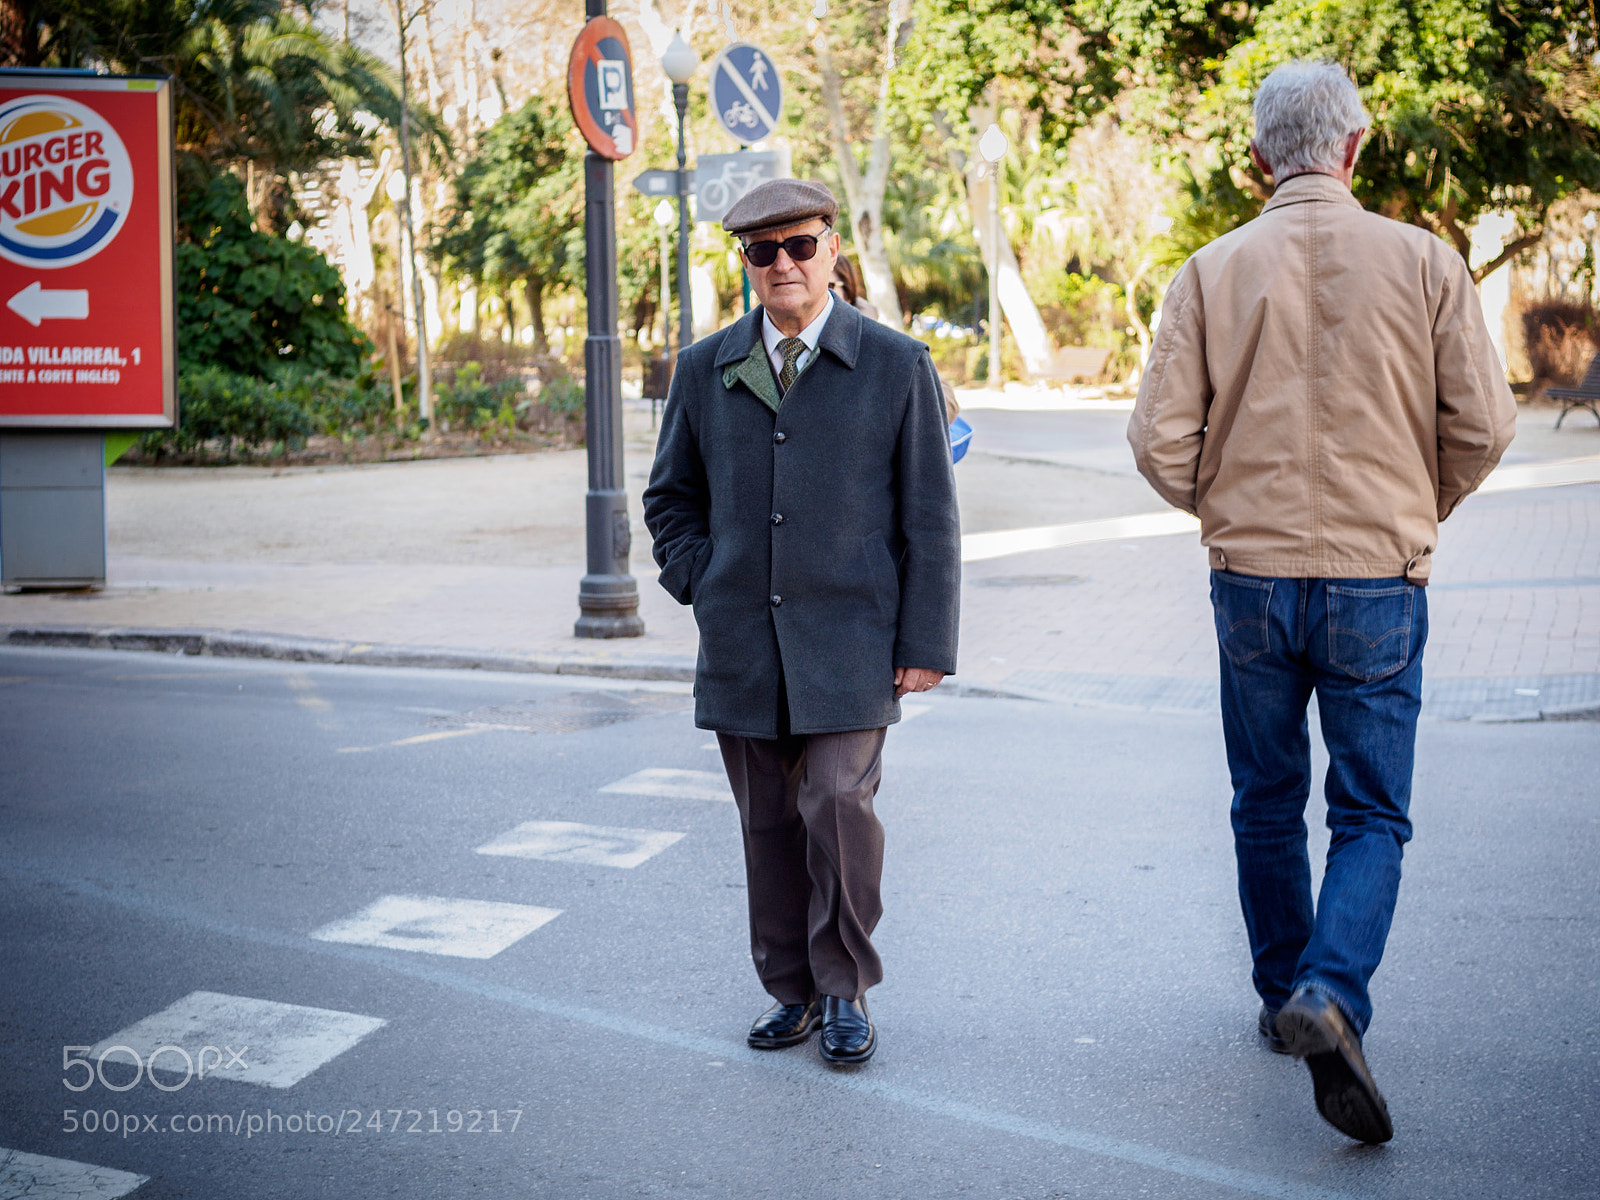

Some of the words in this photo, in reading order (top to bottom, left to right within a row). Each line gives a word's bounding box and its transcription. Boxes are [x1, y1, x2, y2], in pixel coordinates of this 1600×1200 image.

[0, 130, 105, 178] URGER
[0, 158, 111, 221] KING
[27, 346, 128, 367] VILLARREAL,
[131, 346, 141, 366] 1
[27, 369, 37, 383] A
[38, 369, 74, 384] CORTE
[76, 367, 121, 384] INGLÉS)
